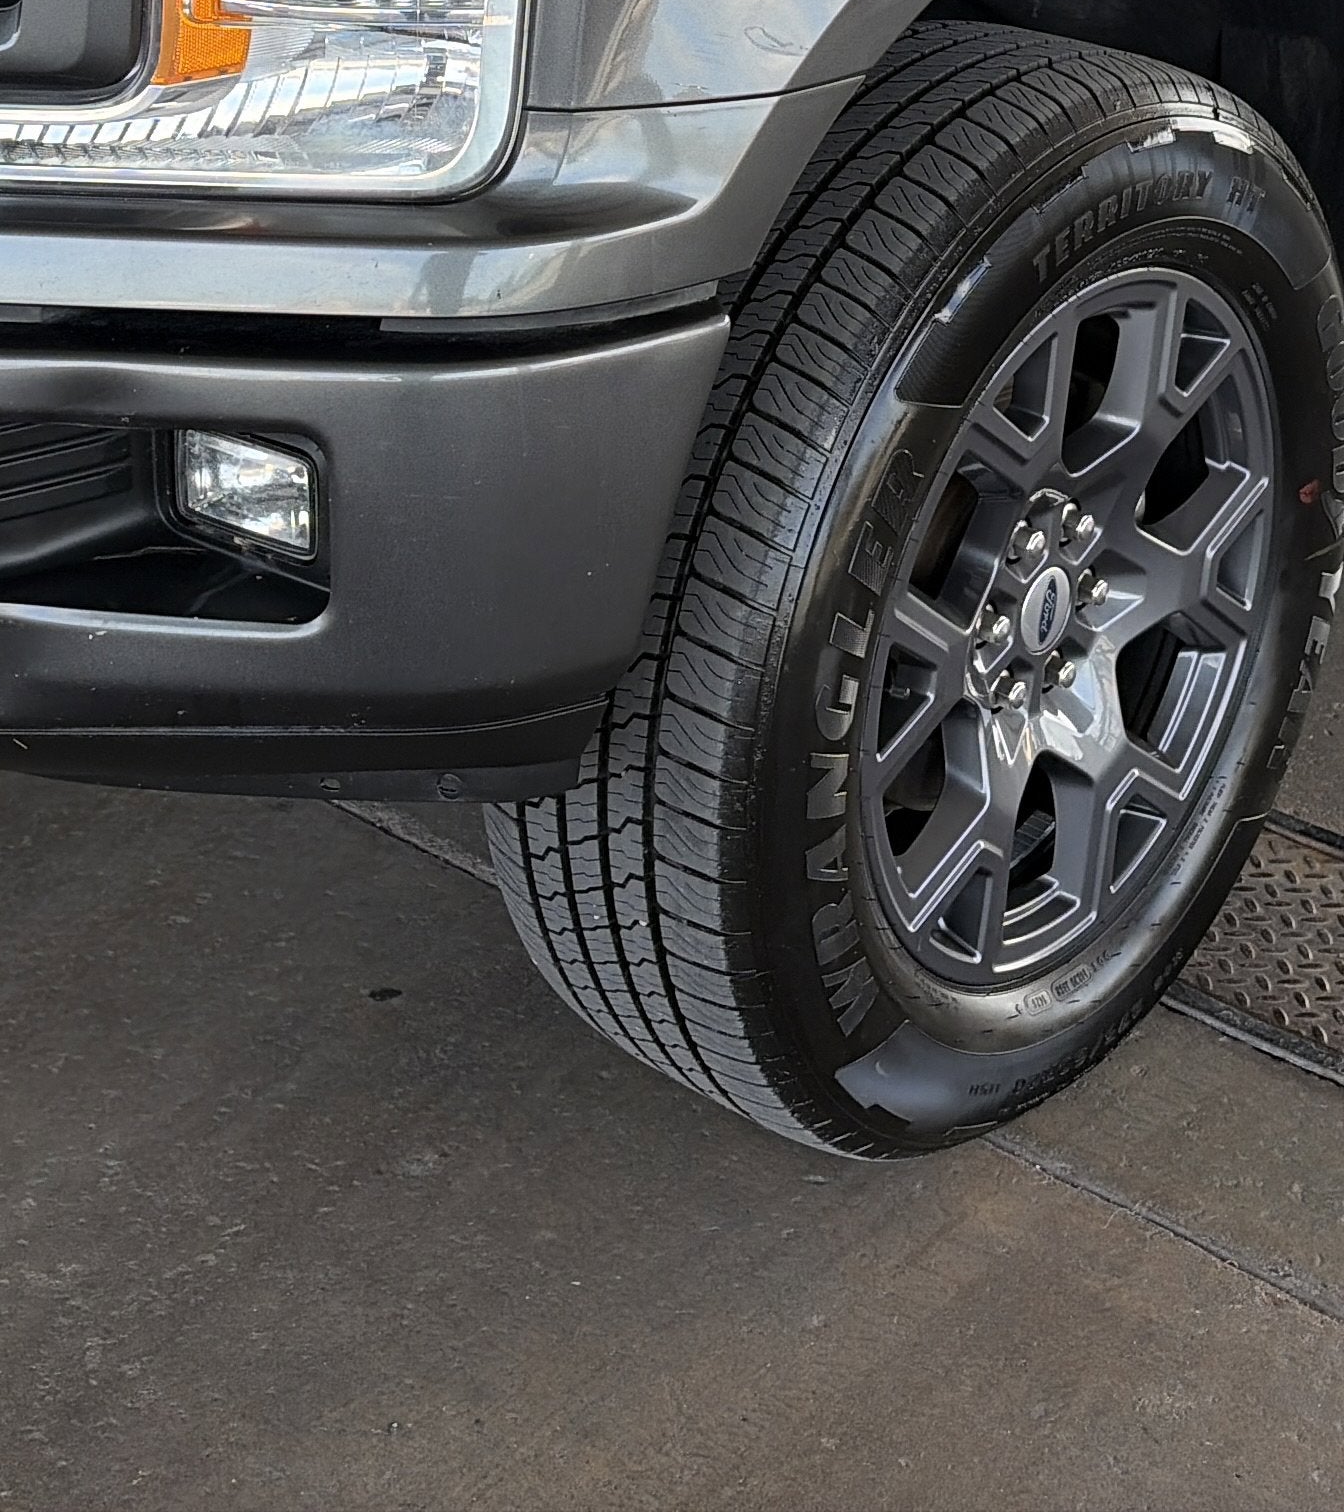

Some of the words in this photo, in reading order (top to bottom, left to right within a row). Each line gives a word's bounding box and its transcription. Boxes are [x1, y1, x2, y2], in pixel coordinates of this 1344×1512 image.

[1031, 169, 1215, 284] TERRITORY
[1039, 588, 1056, 634] Ford
[804, 445, 926, 1038] WRANGLER
